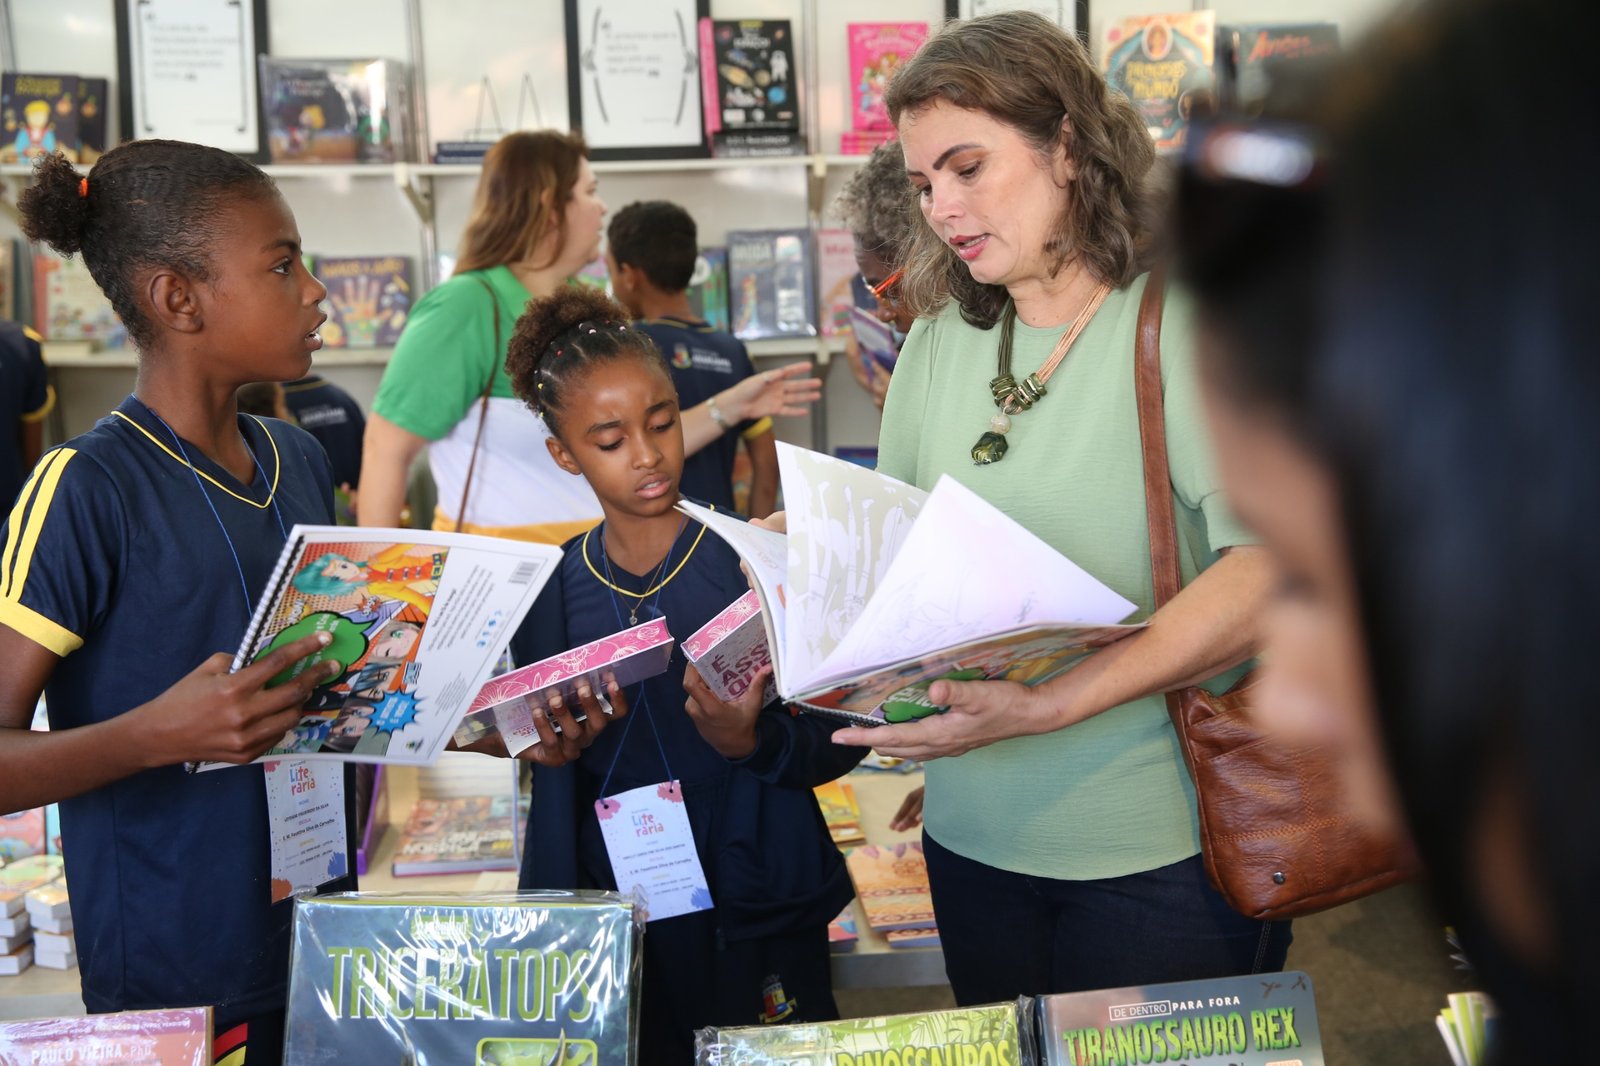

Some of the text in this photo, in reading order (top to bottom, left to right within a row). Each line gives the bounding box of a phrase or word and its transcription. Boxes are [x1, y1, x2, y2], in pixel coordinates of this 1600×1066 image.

[712, 654, 730, 674] É
[722, 639, 769, 687] ASS
[327, 945, 596, 1023] TRICERATOPS
[1113, 996, 1241, 1018] DE DENTRO PARA FORA
[1062, 1006, 1302, 1066] TIRANOSSAURO REX
[31, 1047, 74, 1064] PAULO
